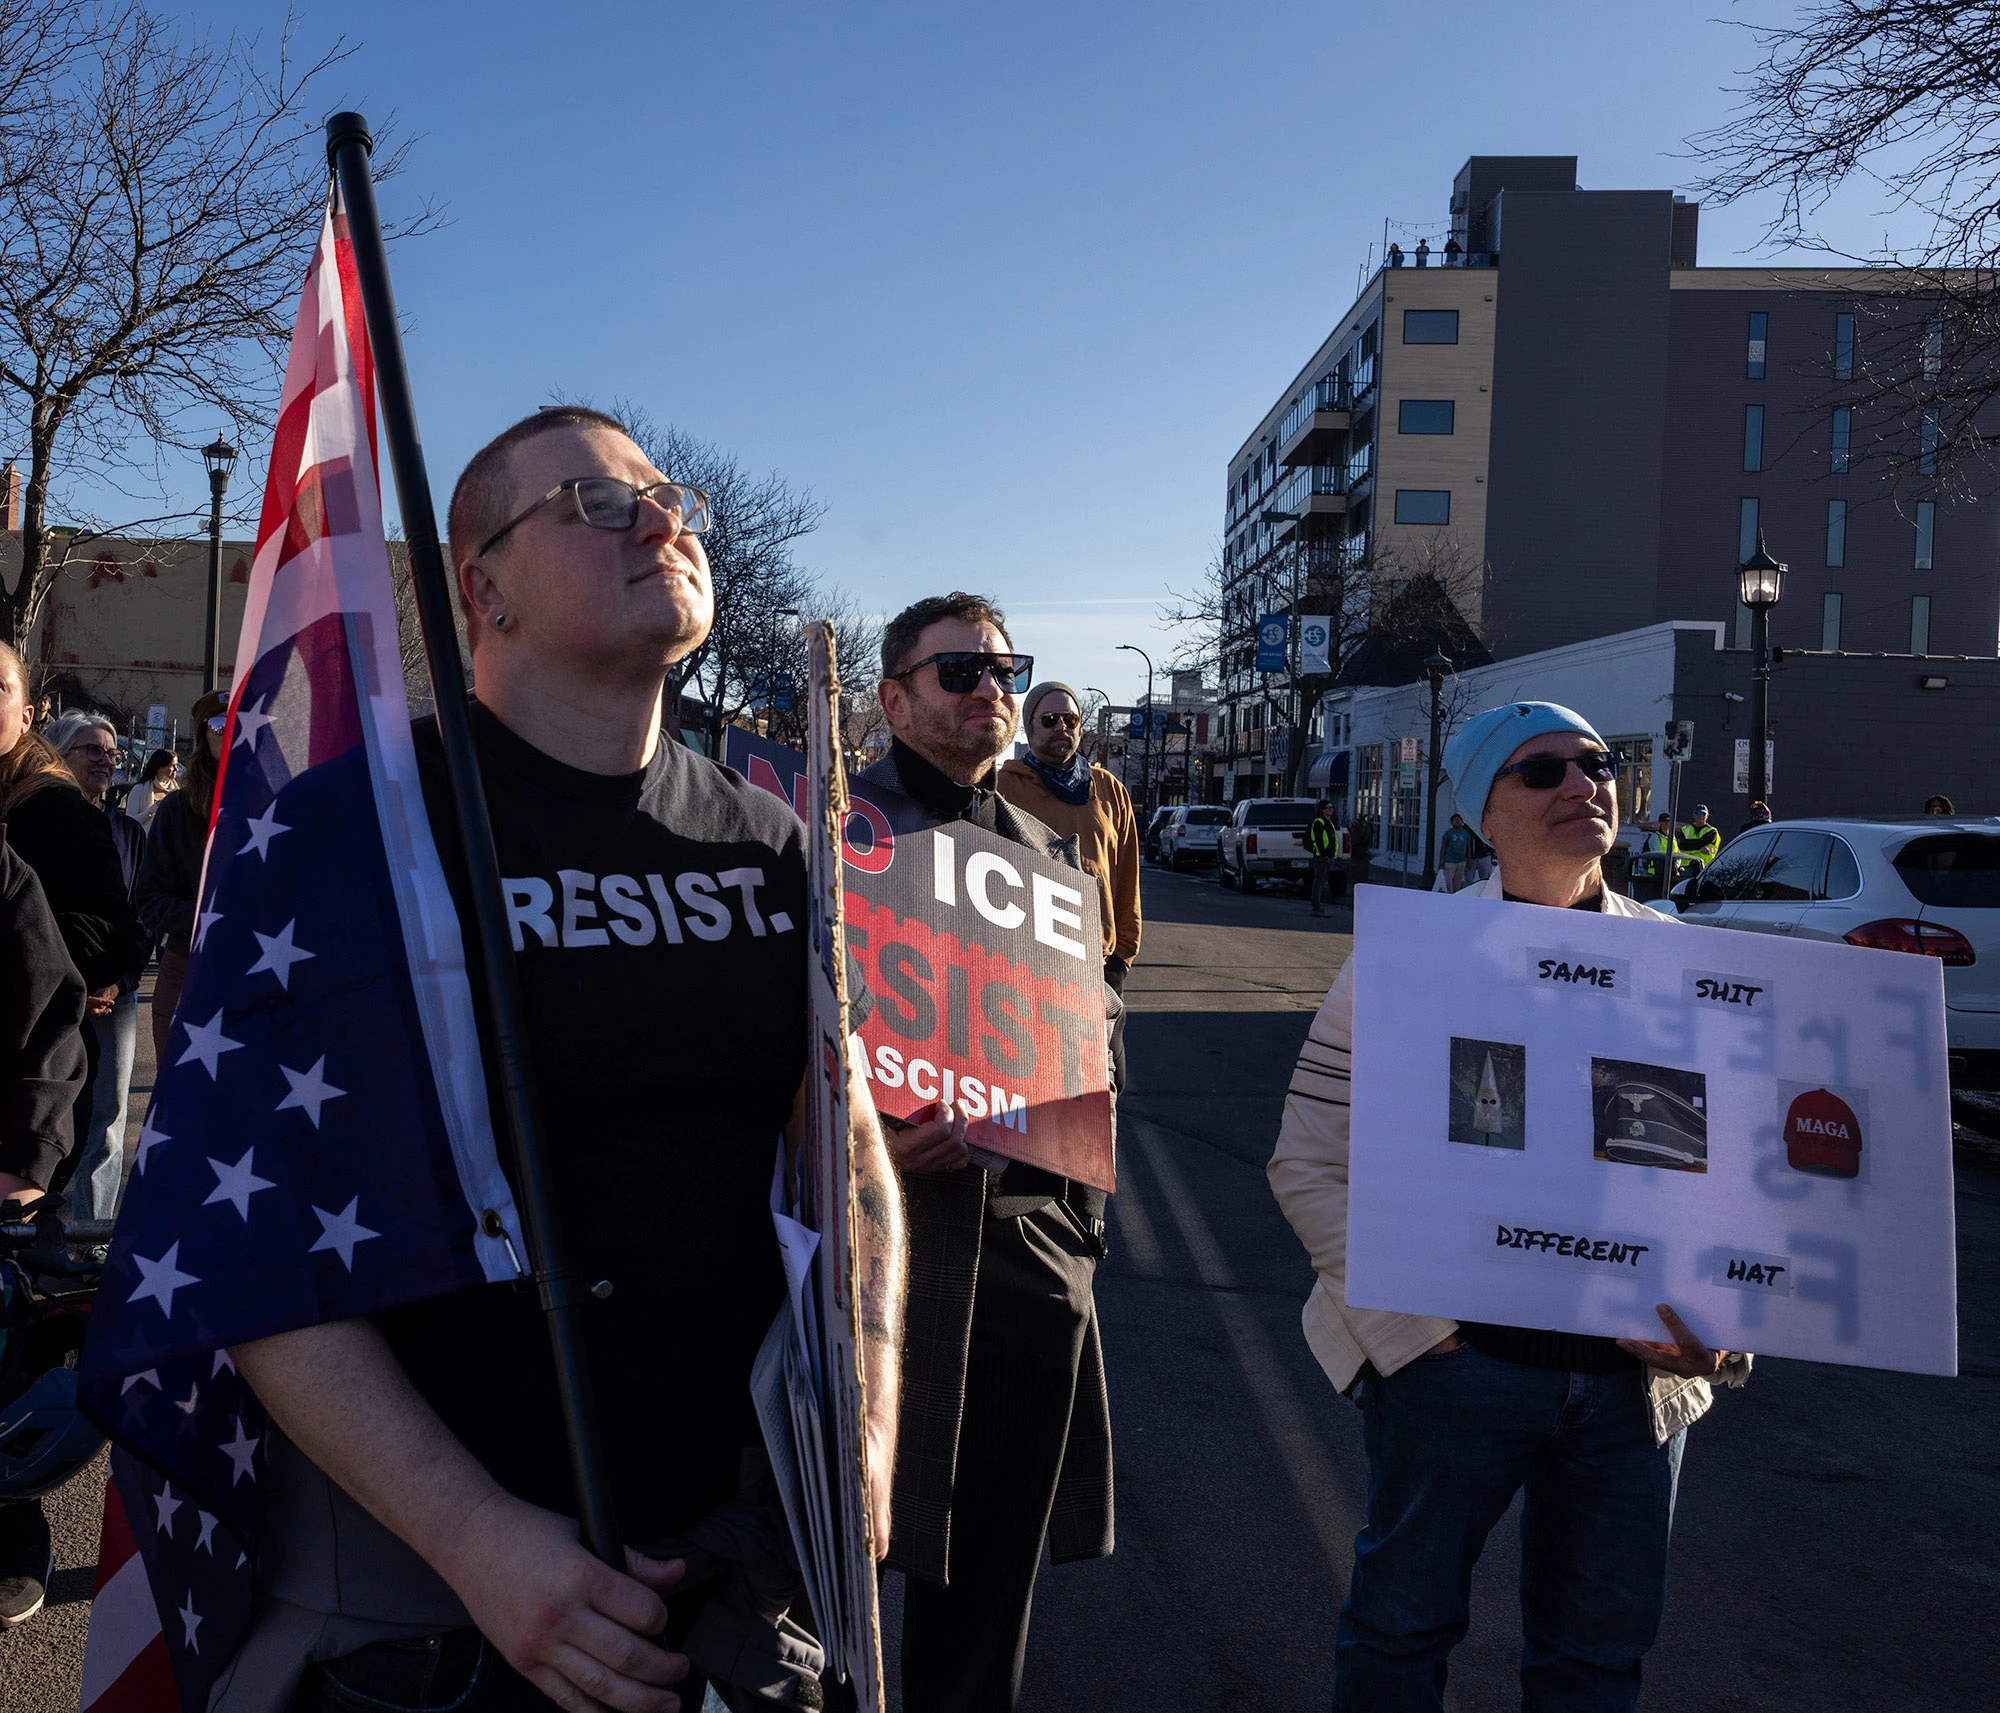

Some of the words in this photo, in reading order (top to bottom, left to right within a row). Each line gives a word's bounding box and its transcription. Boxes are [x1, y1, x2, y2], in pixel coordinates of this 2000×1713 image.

[1750, 346, 1763, 354] ICE
[748, 754, 895, 874] NO
[934, 830, 1086, 961] ICE
[501, 867, 794, 951] RESIST.
[844, 921, 1098, 1102] SIST
[1537, 959, 1616, 989] SAME
[1696, 979, 1763, 1006] SHIT
[1796, 1116, 1851, 1141] MAGA
[1495, 1225, 1649, 1267] DIFFERENT
[1727, 1258, 1786, 1287] HAT
